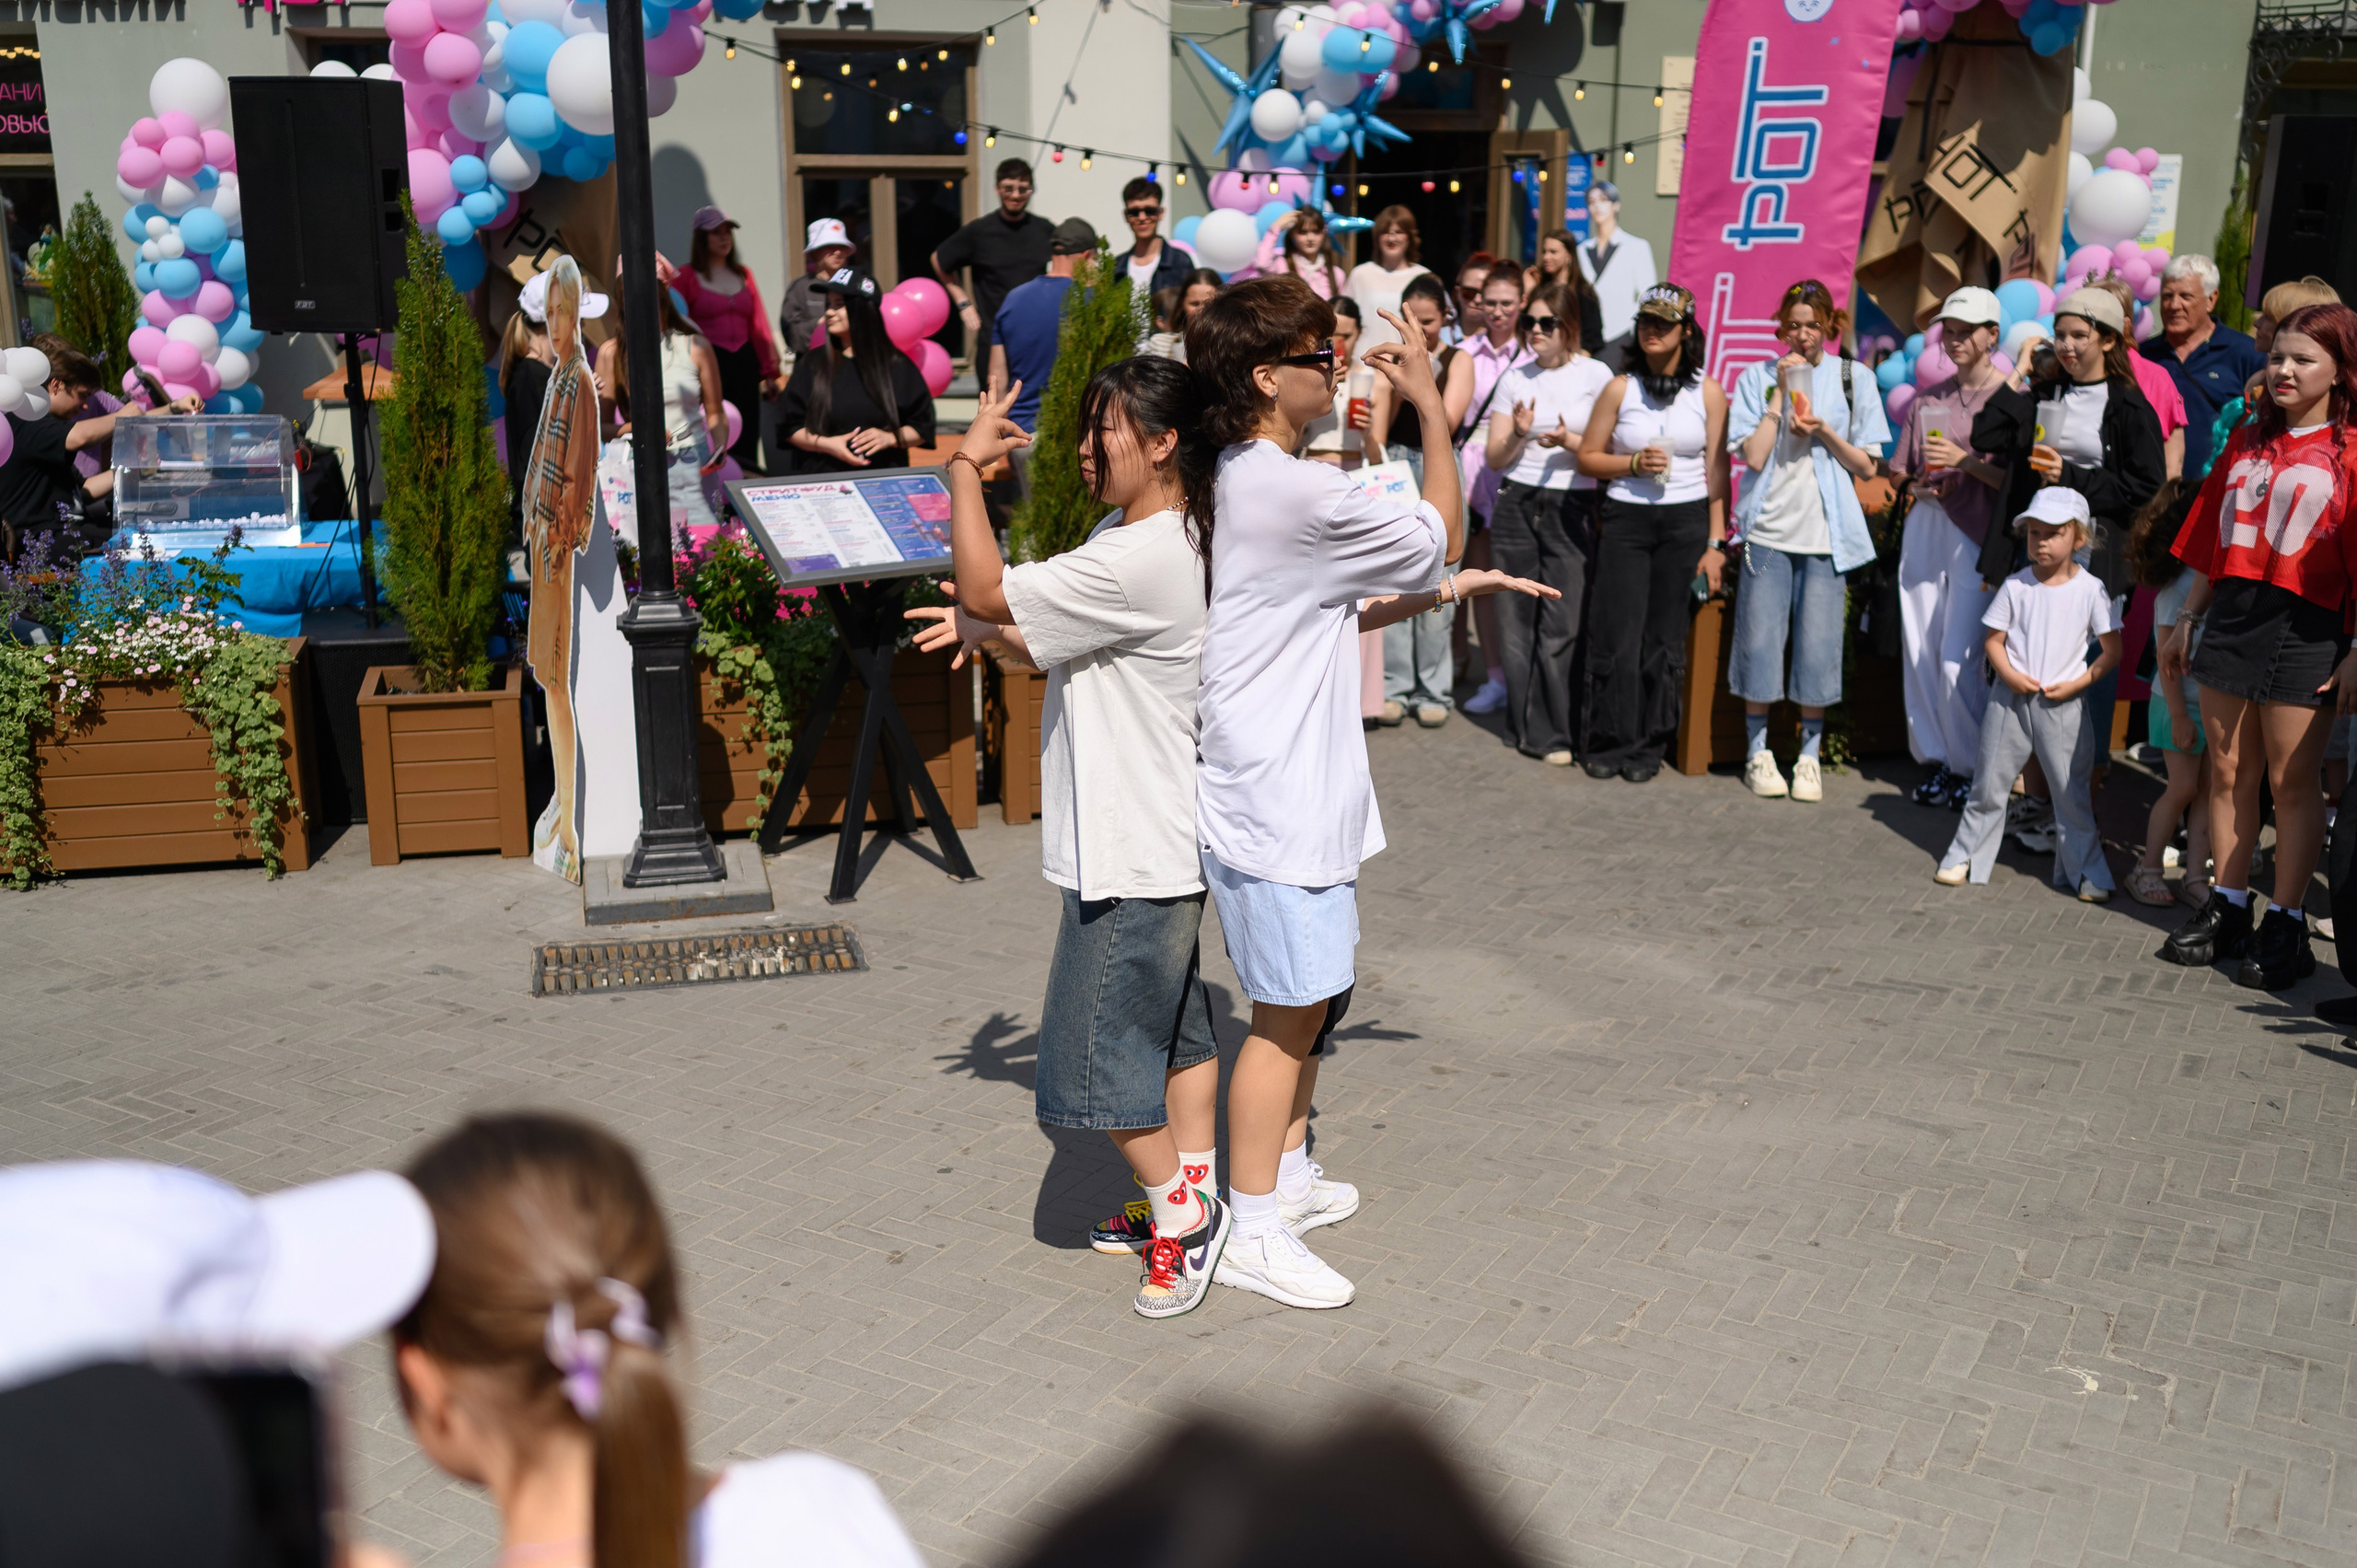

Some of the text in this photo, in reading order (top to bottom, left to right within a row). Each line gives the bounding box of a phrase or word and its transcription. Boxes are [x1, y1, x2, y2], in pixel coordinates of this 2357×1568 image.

[1721, 36, 1829, 251] POT
[751, 493, 801, 503] МЕНЮ
[2220, 459, 2334, 556] 20
